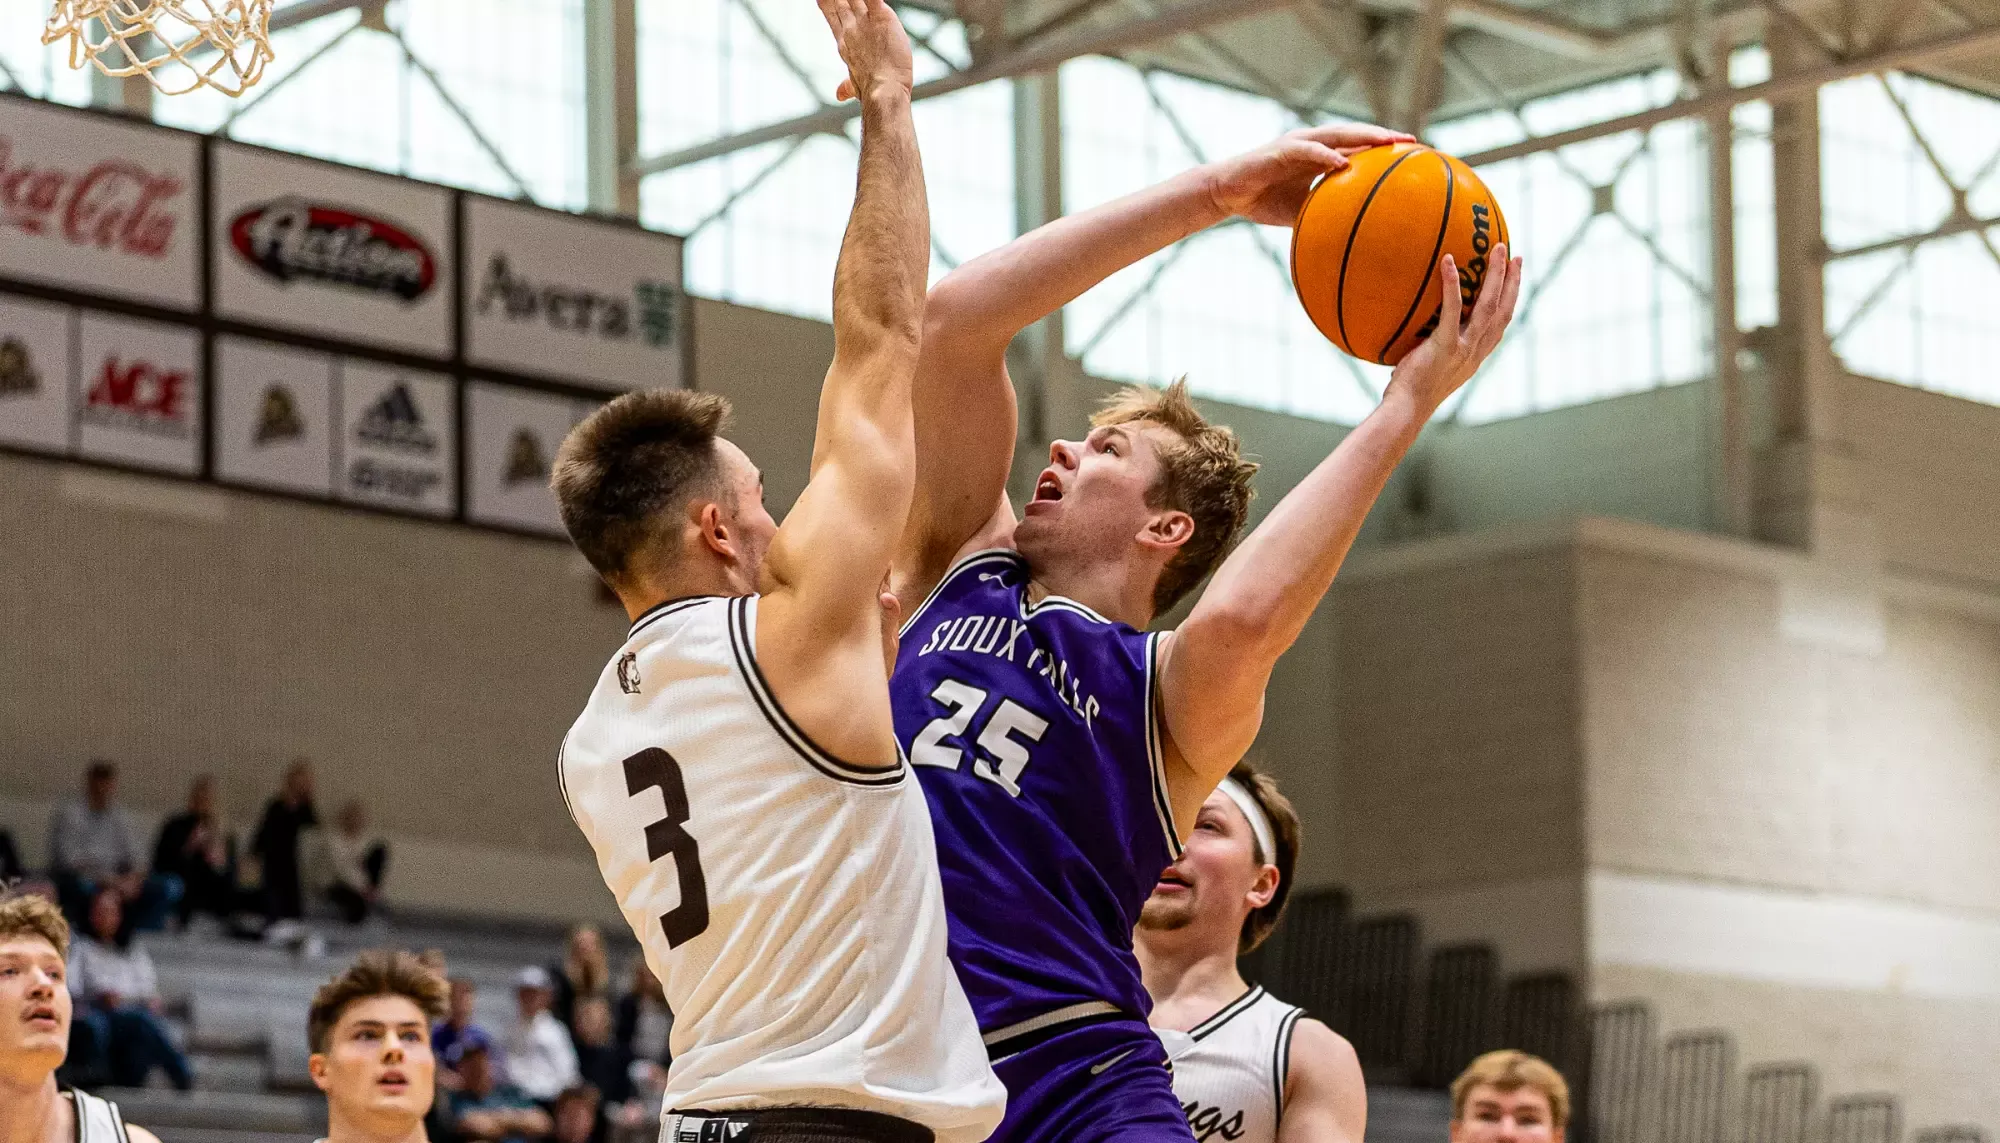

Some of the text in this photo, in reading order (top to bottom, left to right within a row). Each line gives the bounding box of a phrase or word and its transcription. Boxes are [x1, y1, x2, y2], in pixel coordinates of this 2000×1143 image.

[918, 615, 1027, 662] SIOUX
[910, 678, 1050, 798] 25
[622, 746, 710, 950] 3
